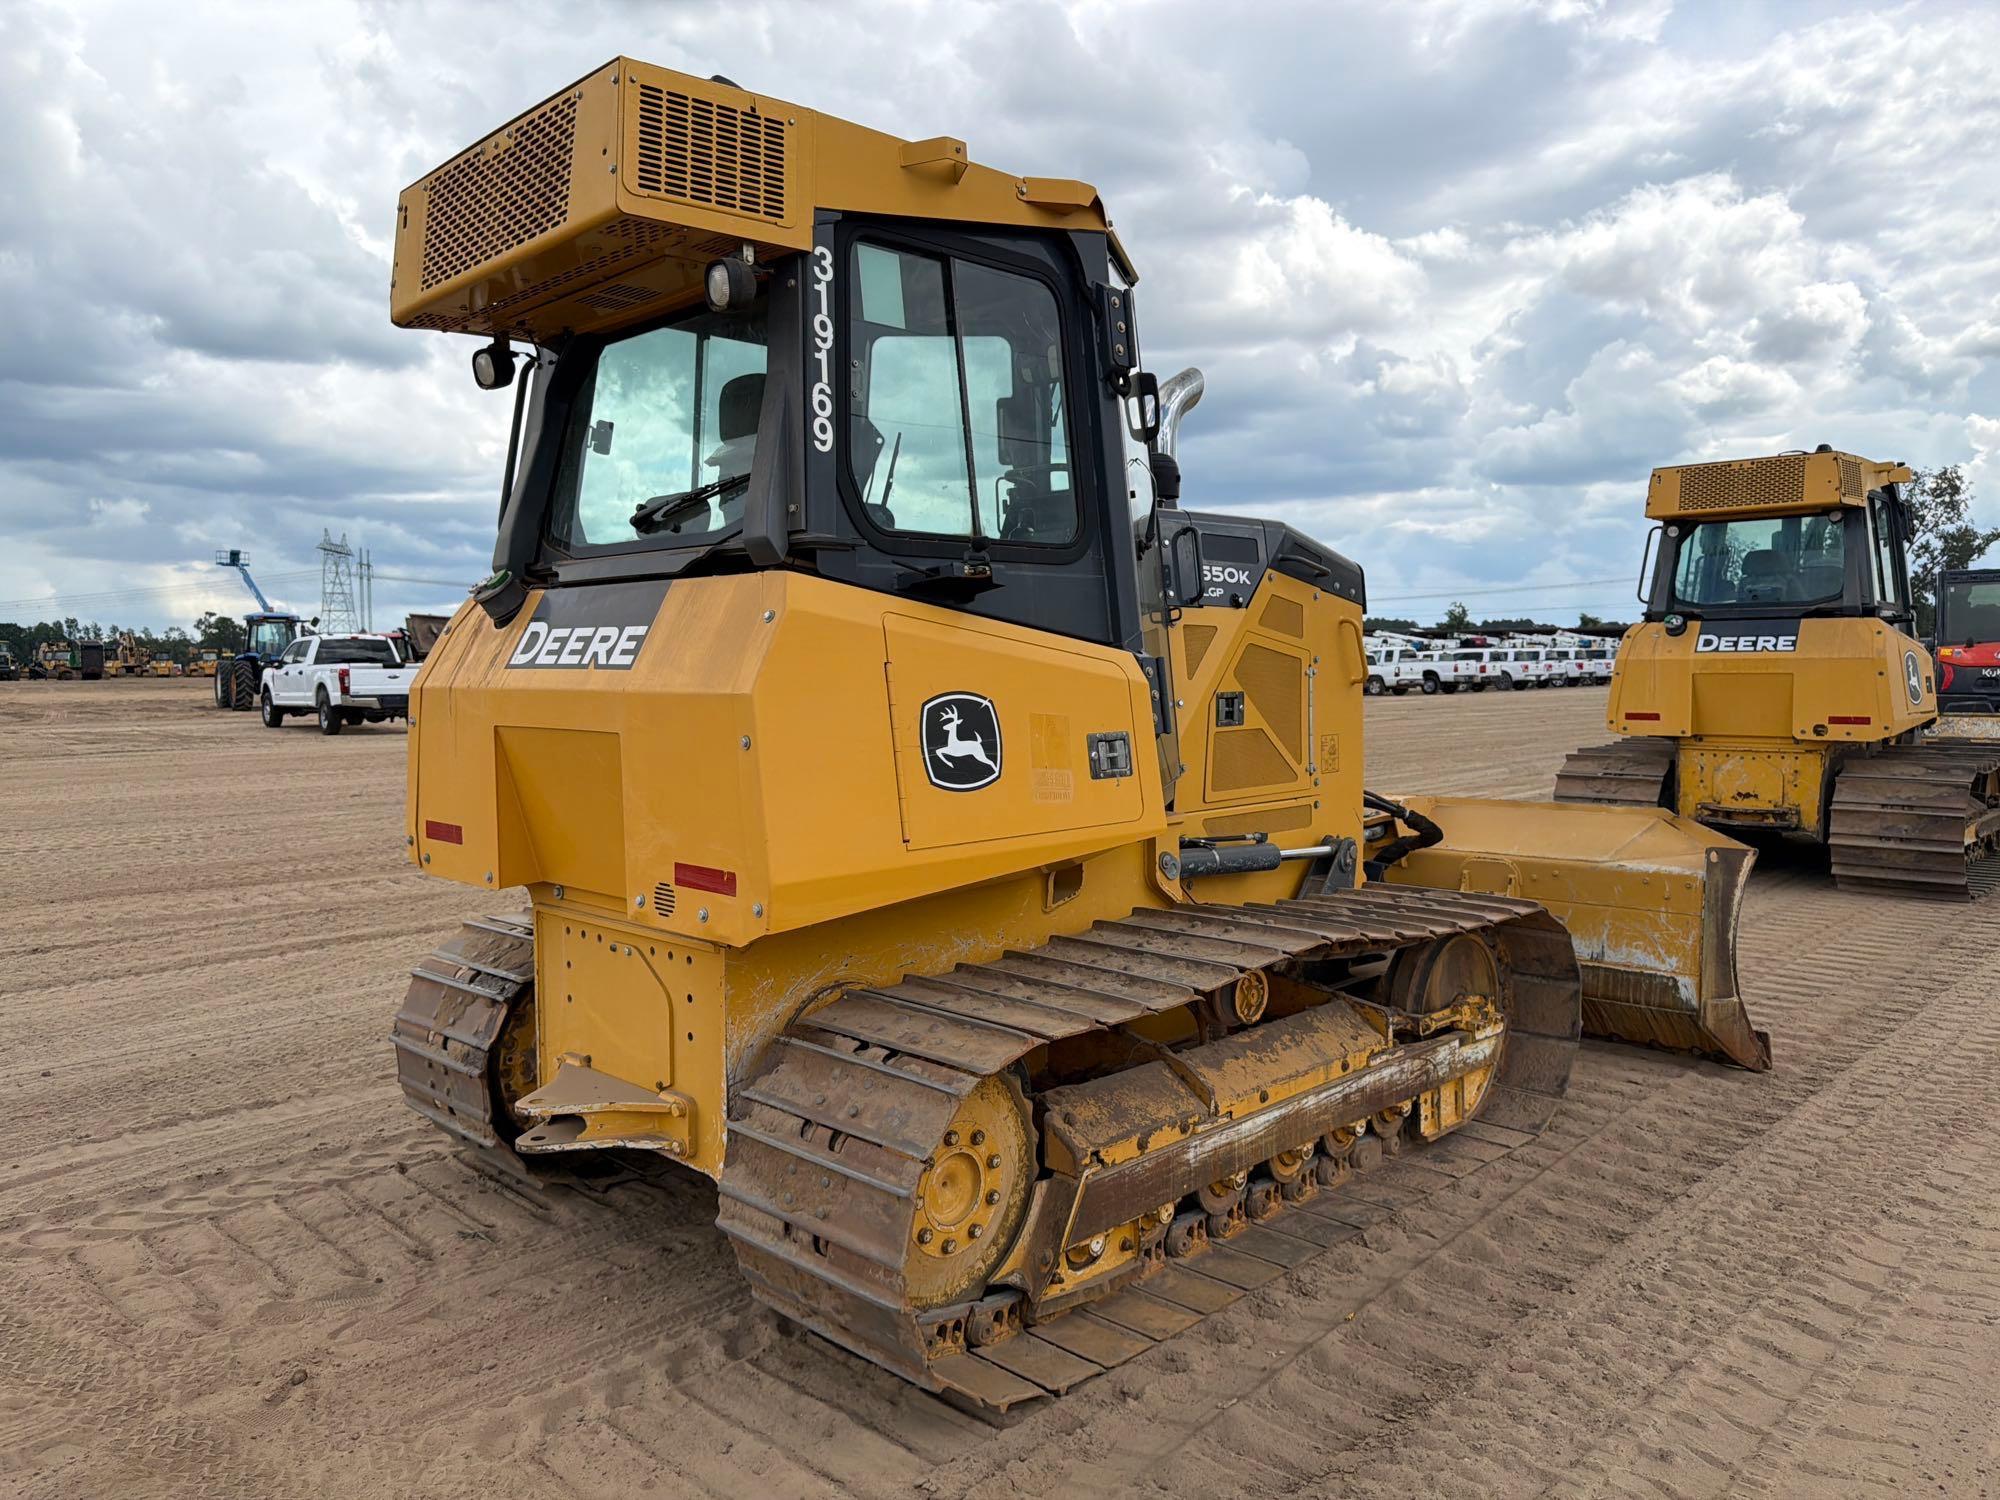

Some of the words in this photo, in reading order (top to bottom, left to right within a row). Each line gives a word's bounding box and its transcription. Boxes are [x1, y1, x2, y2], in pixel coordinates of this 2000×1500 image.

[812, 246, 834, 453] 319169
[509, 621, 649, 666] DEERE
[1696, 634, 1797, 652] DEERE
